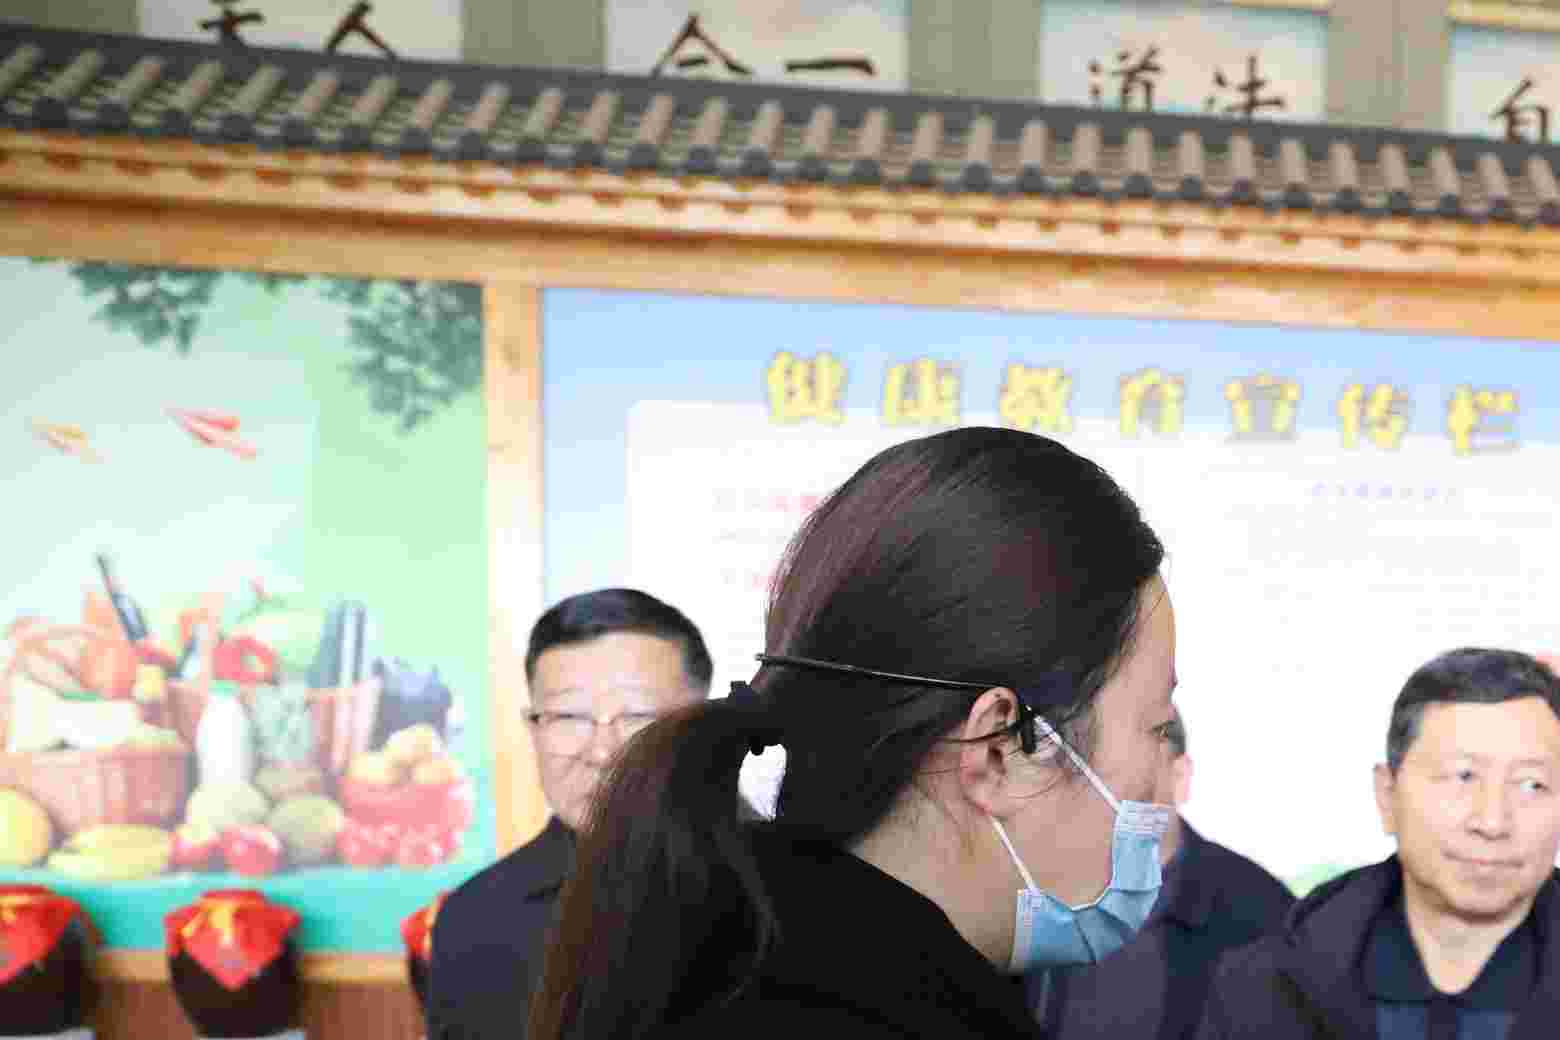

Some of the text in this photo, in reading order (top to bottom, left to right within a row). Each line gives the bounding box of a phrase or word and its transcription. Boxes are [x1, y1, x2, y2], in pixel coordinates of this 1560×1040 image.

[764, 348, 1522, 456] 健康教育宣传栏
